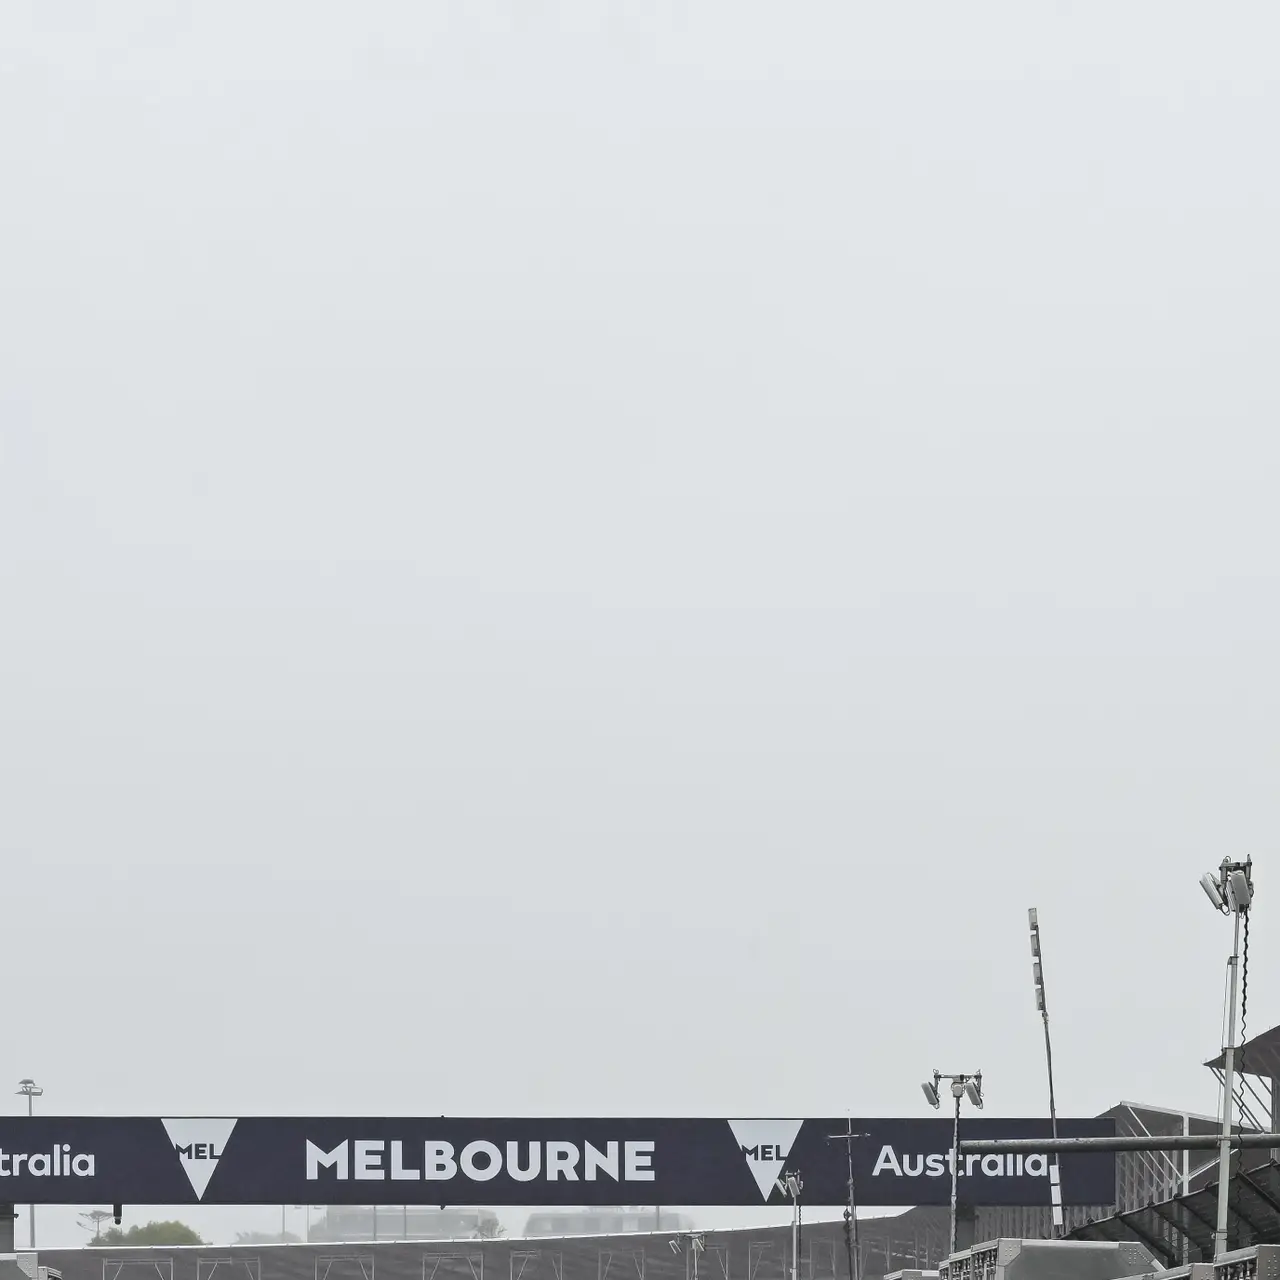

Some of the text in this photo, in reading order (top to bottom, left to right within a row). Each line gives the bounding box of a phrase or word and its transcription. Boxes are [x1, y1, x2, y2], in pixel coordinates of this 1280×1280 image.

[175, 1143, 221, 1160] MEL
[306, 1138, 655, 1182] MELBOURNE
[741, 1144, 786, 1161] MEL
